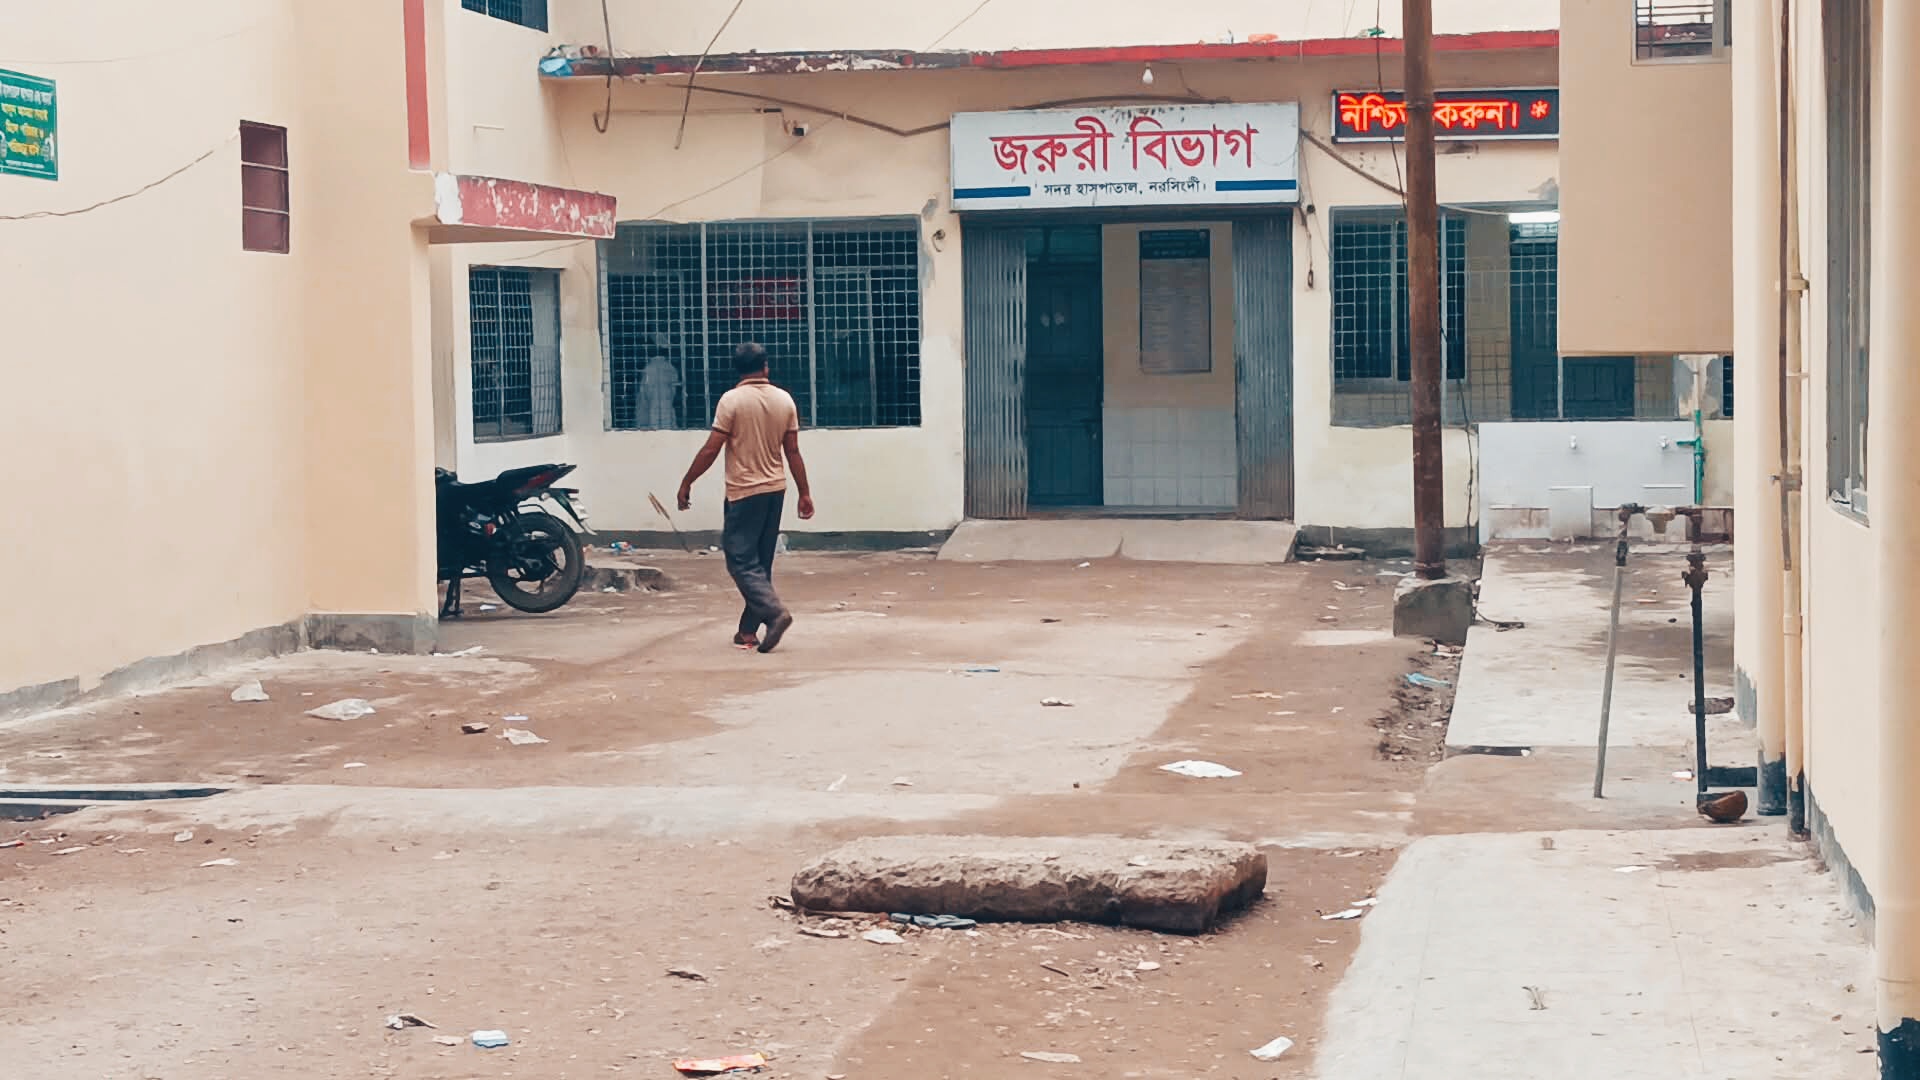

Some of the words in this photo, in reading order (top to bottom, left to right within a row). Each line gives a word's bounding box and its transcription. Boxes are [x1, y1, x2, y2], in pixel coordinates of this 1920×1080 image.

[989, 115, 1115, 174] জরুরী
[1127, 114, 1259, 170] বিভাগ
[1043, 184, 1072, 196] সদর
[1075, 182, 1143, 195] হাসপাতাল,
